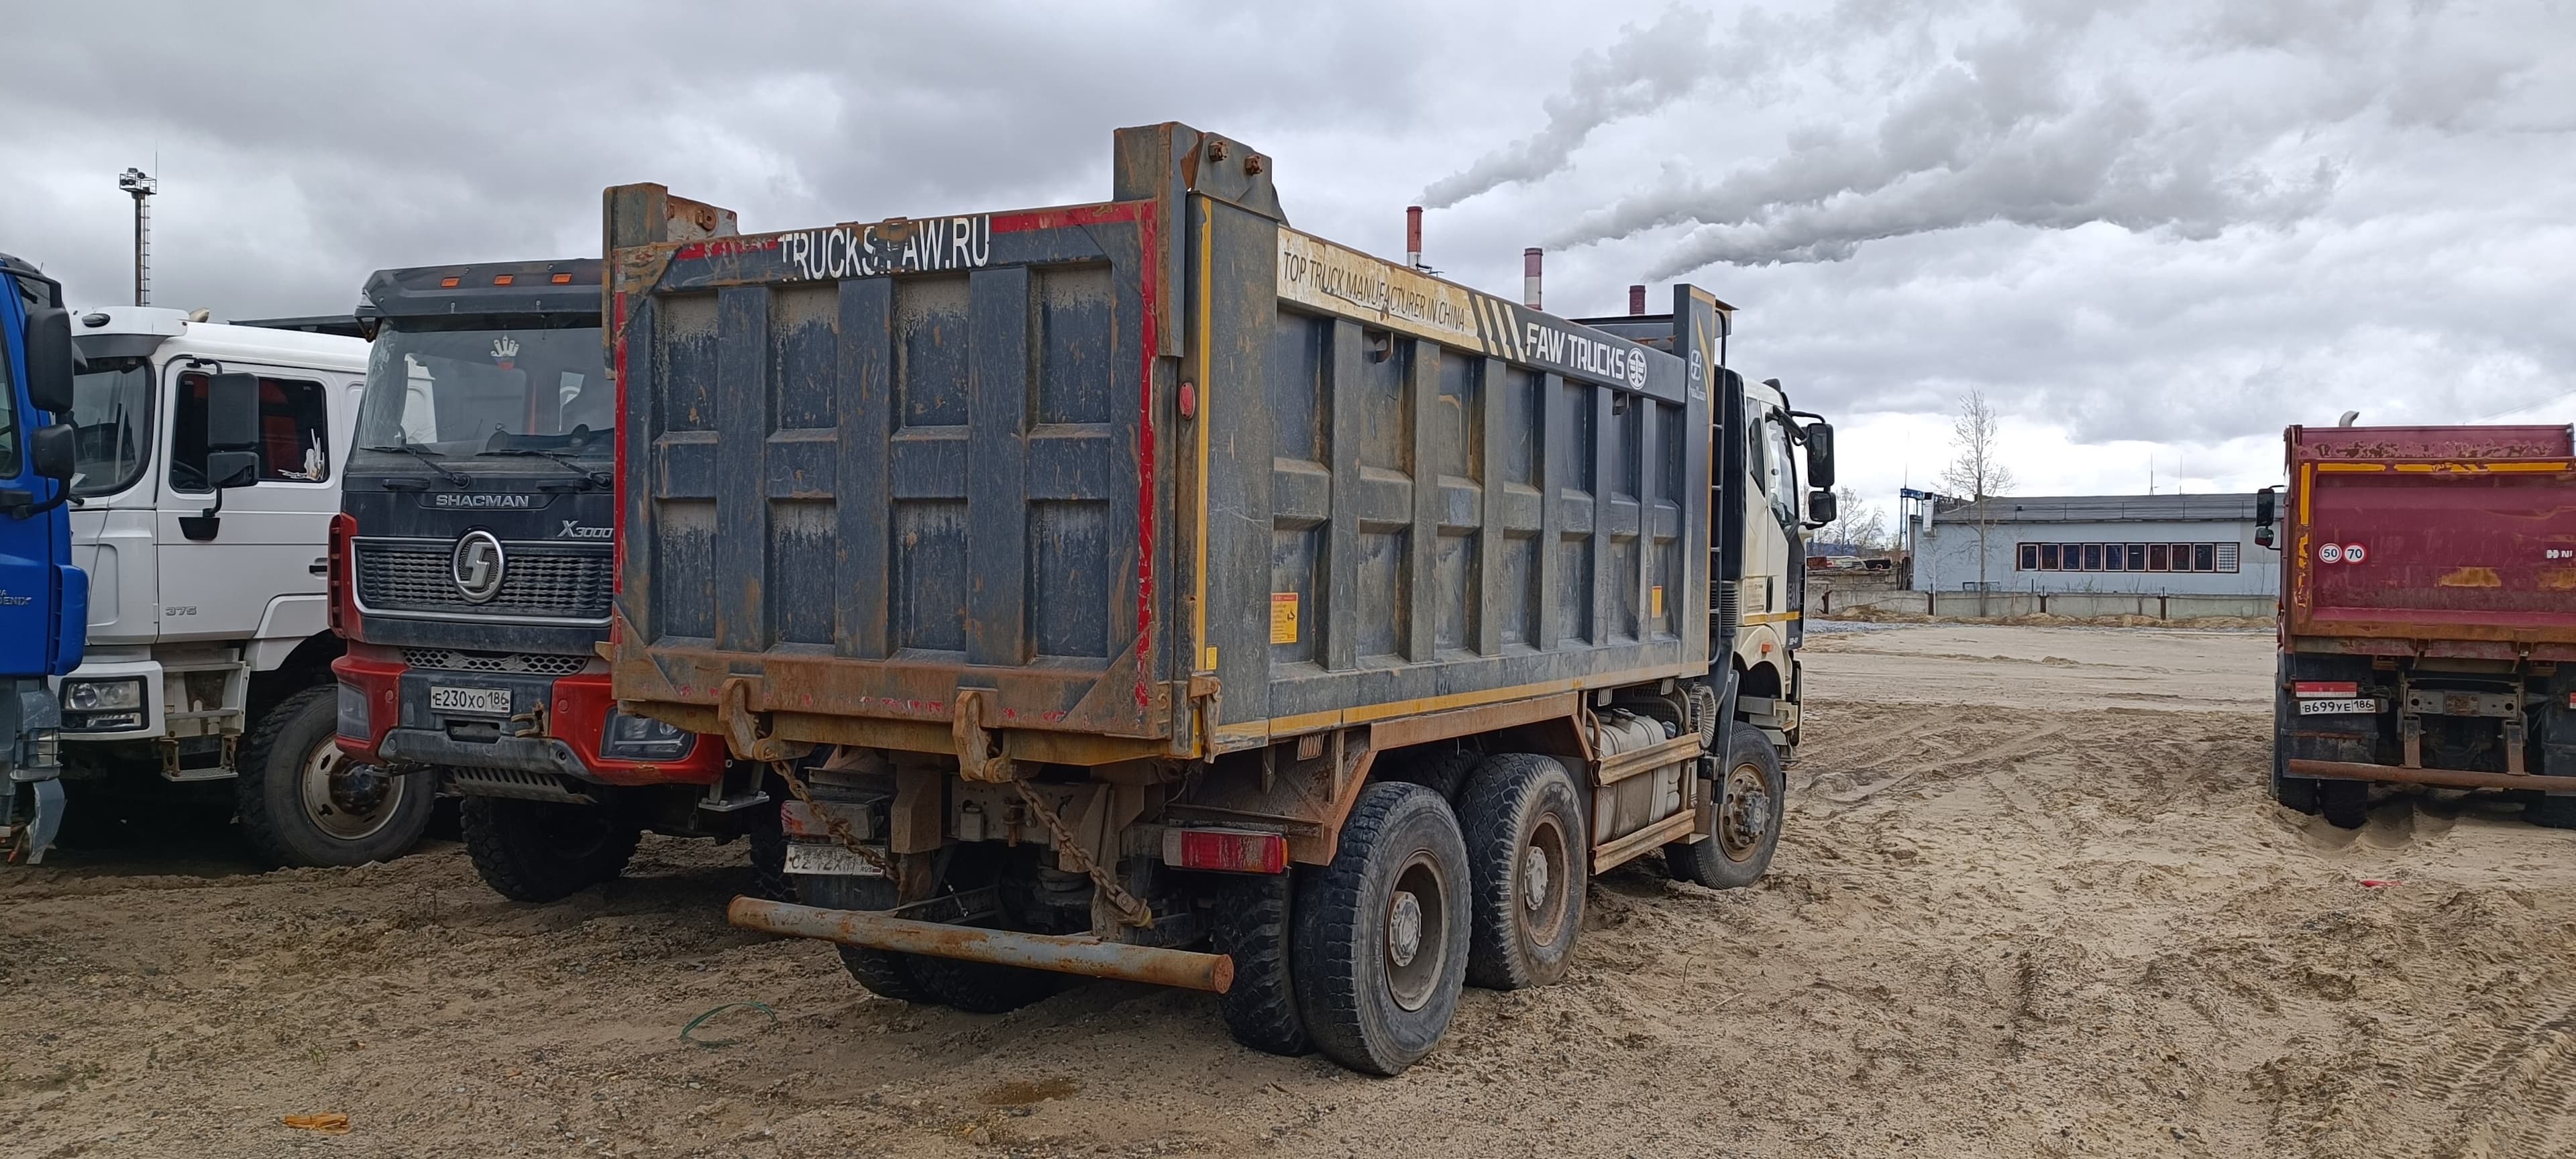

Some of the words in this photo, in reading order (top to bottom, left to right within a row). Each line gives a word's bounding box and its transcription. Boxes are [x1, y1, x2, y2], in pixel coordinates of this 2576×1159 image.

[1284, 251, 1306, 284] TOP
[1310, 260, 1344, 296] TRUCK
[1346, 273, 1426, 319] MANUFACTURER
[1426, 298, 1438, 321] IN
[1438, 301, 1464, 331] CHINA
[1526, 322, 1566, 364] FAW
[1568, 335, 1625, 380] TRUCKS
[436, 494, 529, 507] SHACMAN
[557, 520, 614, 538] X3000
[2323, 549, 2338, 558] 50
[2347, 549, 2363, 559] 70
[488, 692, 507, 705] 186
[2353, 700, 2371, 708] 186
